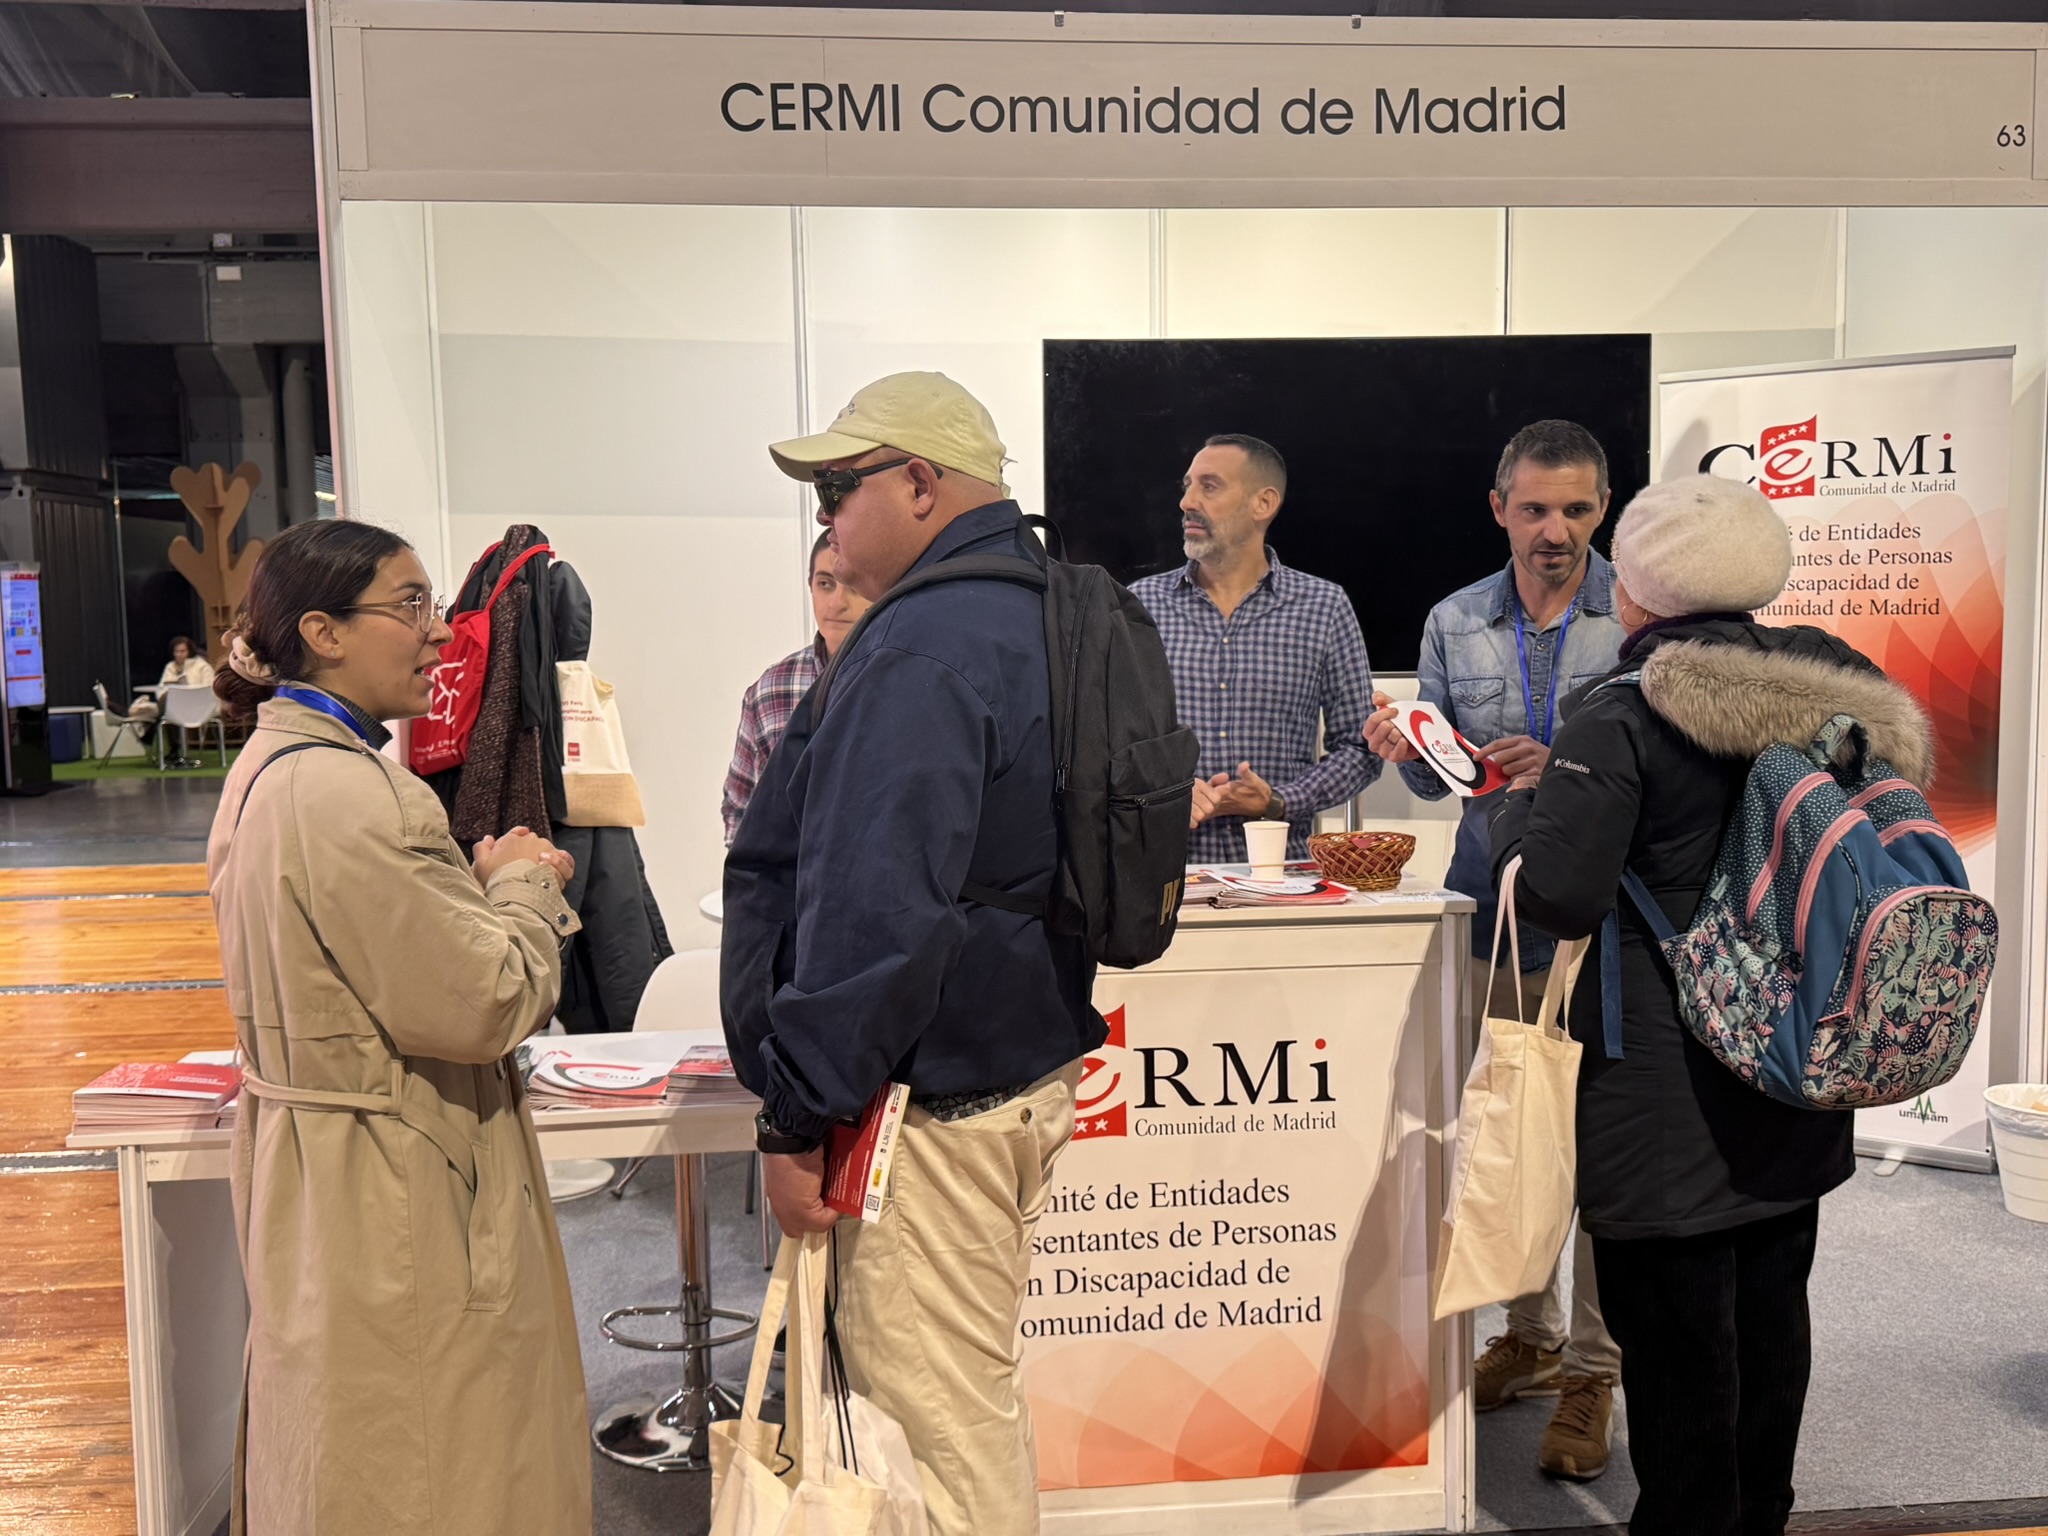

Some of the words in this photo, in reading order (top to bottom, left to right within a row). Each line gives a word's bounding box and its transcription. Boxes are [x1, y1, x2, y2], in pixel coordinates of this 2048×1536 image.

[721, 83, 900, 132] CERMI
[922, 83, 1259, 134] Comunidad
[1280, 87, 1354, 135] de
[1375, 84, 1567, 134] Madrid
[1996, 124, 2026, 148] 63
[1819, 481, 1887, 497] Comunidad
[1891, 481, 1907, 494] de
[1911, 478, 1956, 493] Madrid
[1799, 525, 1821, 542] de
[1828, 521, 1921, 541] Entidades
[1838, 548, 1861, 566] de
[1868, 547, 1953, 567] Personas
[1783, 573, 1890, 596] scapacidad
[1896, 572, 1919, 590] de
[1840, 598, 1863, 616] de
[1869, 597, 1940, 616] Madrid
[1560, 758, 1590, 774] Columbia
[1134, 1114, 1236, 1137] Comunidad
[1243, 1113, 1265, 1132] de
[1273, 1110, 1336, 1131] Madrid
[1105, 1183, 1139, 1211] de
[1149, 1177, 1290, 1209] Entidades
[1031, 1228, 1159, 1255] sentantes
[1169, 1221, 1202, 1248] de
[1211, 1220, 1337, 1247] Personas
[1053, 1258, 1247, 1299] Discapacidad
[1257, 1257, 1290, 1284] de
[1020, 1303, 1164, 1338] omunidad
[1174, 1302, 1208, 1330] de
[1217, 1295, 1322, 1328] Madrid
